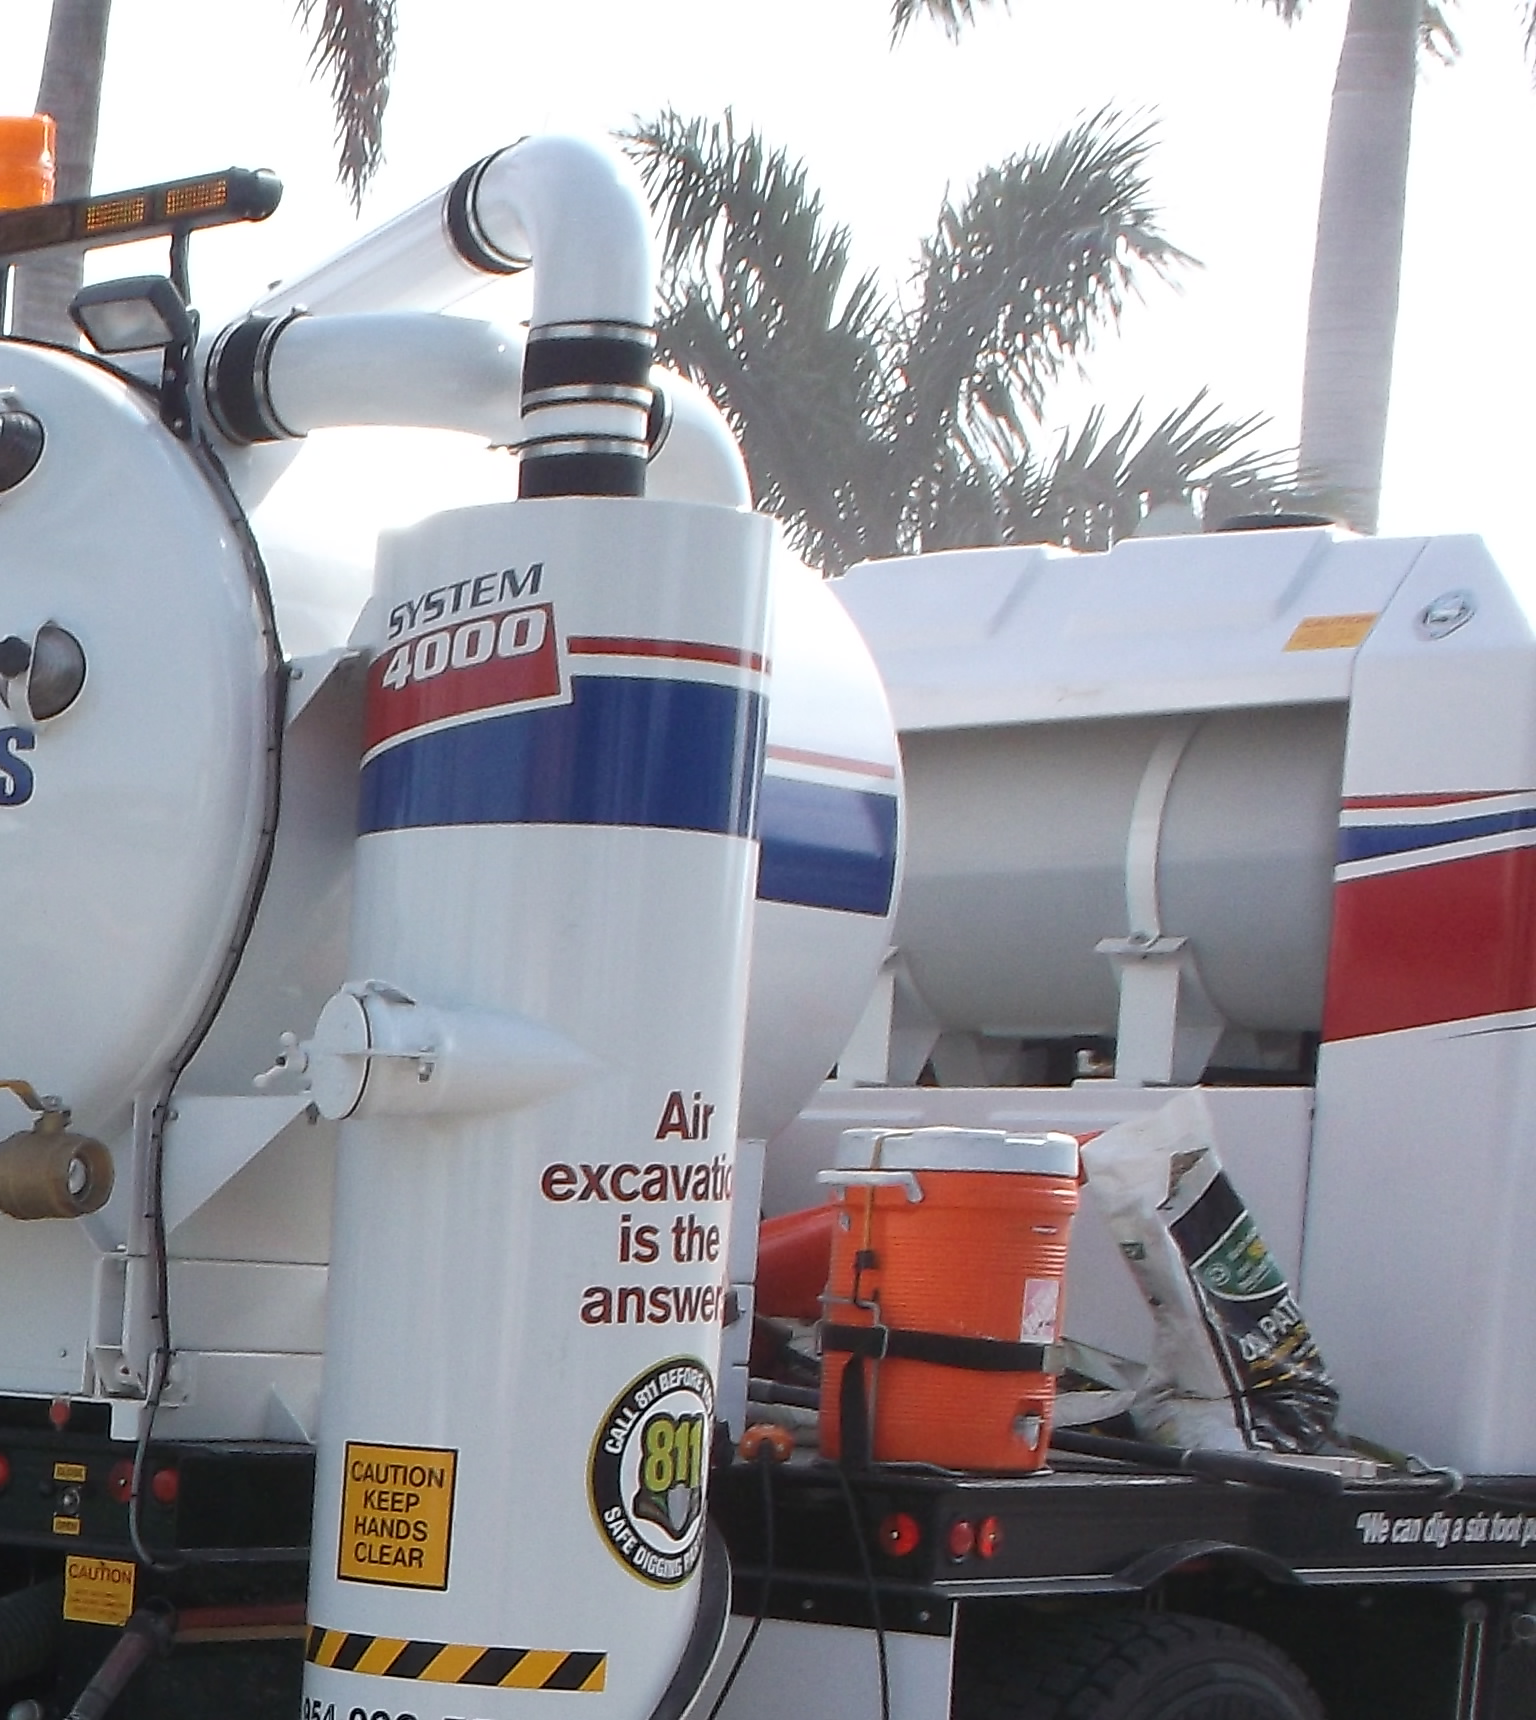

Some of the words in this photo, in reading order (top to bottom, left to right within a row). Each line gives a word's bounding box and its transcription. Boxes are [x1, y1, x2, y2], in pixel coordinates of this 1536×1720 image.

[388, 562, 544, 641] SYSTEM
[381, 608, 547, 691] 4000
[655, 1090, 715, 1140] Air
[540, 1153, 733, 1202] excavati
[618, 1213, 661, 1263] is
[671, 1213, 721, 1263] the
[604, 1408, 642, 1456] CALL
[634, 1380, 662, 1407] 811
[658, 1366, 704, 1396] BEFORE
[352, 1460, 446, 1489] CAUTION
[642, 1413, 704, 1492] 811
[363, 1489, 421, 1513] KEEP
[354, 1515, 429, 1542] HANDS
[603, 1504, 637, 1556] SAFE
[633, 1548, 683, 1580] DIGGING
[1391, 1517, 1423, 1543] can
[1423, 1511, 1452, 1549] dig
[1451, 1517, 1465, 1543] a
[69, 1563, 132, 1585] CAUTION
[354, 1541, 425, 1569] CLEAR
